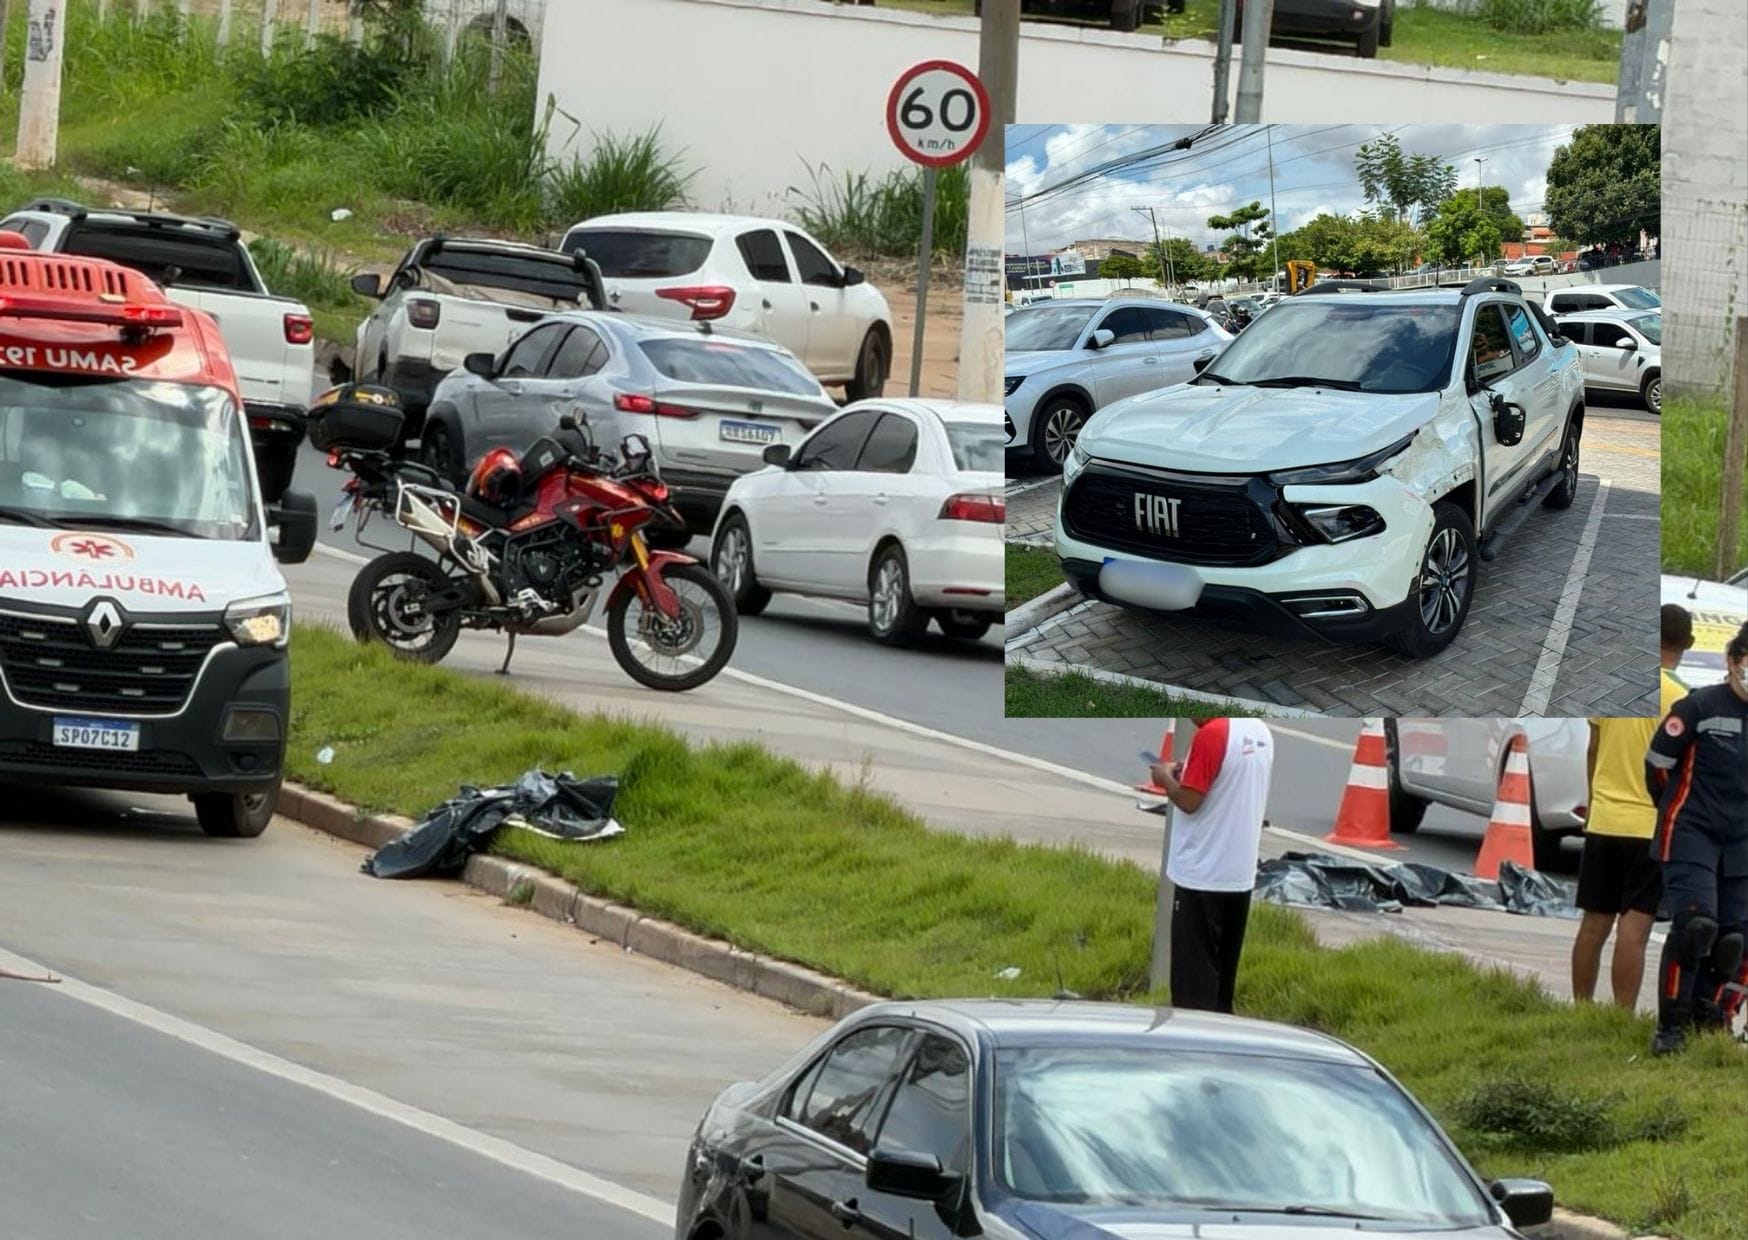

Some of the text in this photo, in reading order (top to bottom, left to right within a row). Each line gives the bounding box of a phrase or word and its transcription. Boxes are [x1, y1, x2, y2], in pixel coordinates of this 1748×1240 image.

[901, 87, 975, 132] 60
[918, 138, 955, 150] km/h
[1135, 493, 1181, 537] FIAT
